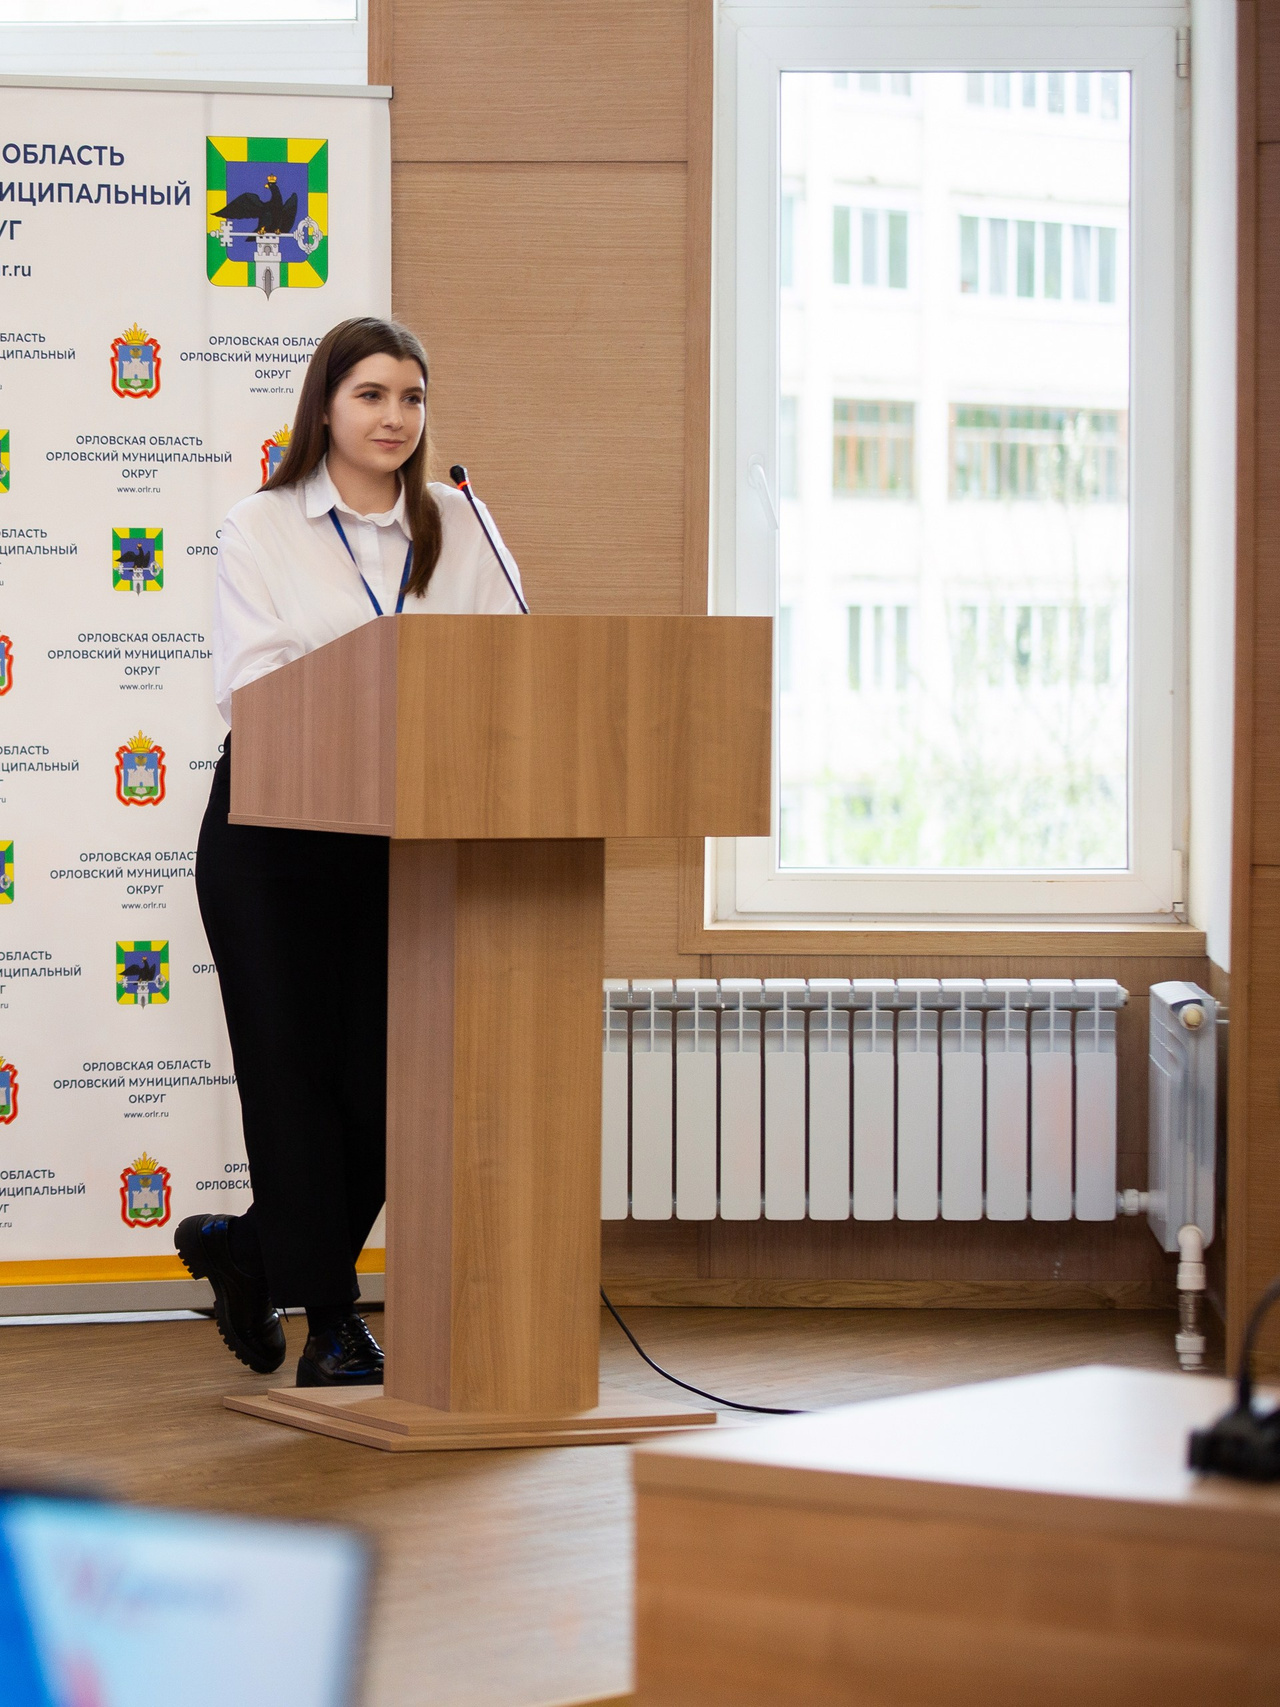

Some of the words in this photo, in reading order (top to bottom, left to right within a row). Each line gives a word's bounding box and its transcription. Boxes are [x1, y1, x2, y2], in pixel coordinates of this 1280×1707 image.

[1, 142, 125, 167] ОБЛАСТЬ
[208, 335, 280, 347] ОРЛОВСКАЯ
[281, 336, 325, 348] ОБЛАС
[179, 350, 252, 363] ОРЛОВСКИЙ
[254, 352, 314, 365] МУНИЦИП
[254, 369, 292, 380] ОКРУГ
[249, 386, 294, 394] www.orlr.ru
[75, 435, 146, 446] ОРЛОВСКАЯ
[148, 435, 203, 447] ОБЛАСТЬ
[45, 449, 119, 462] ОРЛОВСКИЙ
[121, 450, 233, 464] МУНИЦИПАЛЬНЫЙ
[121, 468, 159, 479] ОКРУГ
[116, 486, 161, 494] www.orlr.ru
[77, 632, 149, 643] ОРЛОВСКАЯ
[151, 632, 205, 643] ОБЛАСТЬ
[47, 647, 122, 660] ОРЛОВСКИЙ
[124, 649, 213, 661] МУНИЦИПАЛЬН
[124, 665, 161, 676] ОКРУГ
[119, 682, 164, 691] www.orlr.ru
[79, 851, 152, 863] ОРЛОВСКАЯ
[154, 851, 198, 863] ОБЛАС
[49, 866, 124, 880] ОРЛОВСКИЙ
[126, 866, 196, 880] МУНИЦИПА
[126, 884, 165, 895] ОКРУГ
[121, 901, 167, 910] www.orlr.ru
[82, 1060, 154, 1073] ОРЛОВСКАЯ
[157, 1059, 212, 1071] ОБЛАСТЬ
[53, 1075, 126, 1090] ОРЛОВСКИЙ
[128, 1093, 167, 1104] ОКРУГ
[123, 1110, 170, 1119] www.orlr.ru
[0, 1169, 56, 1181] ОБЛАСТЬ
[195, 1179, 253, 1191] ОРЛОВСК
